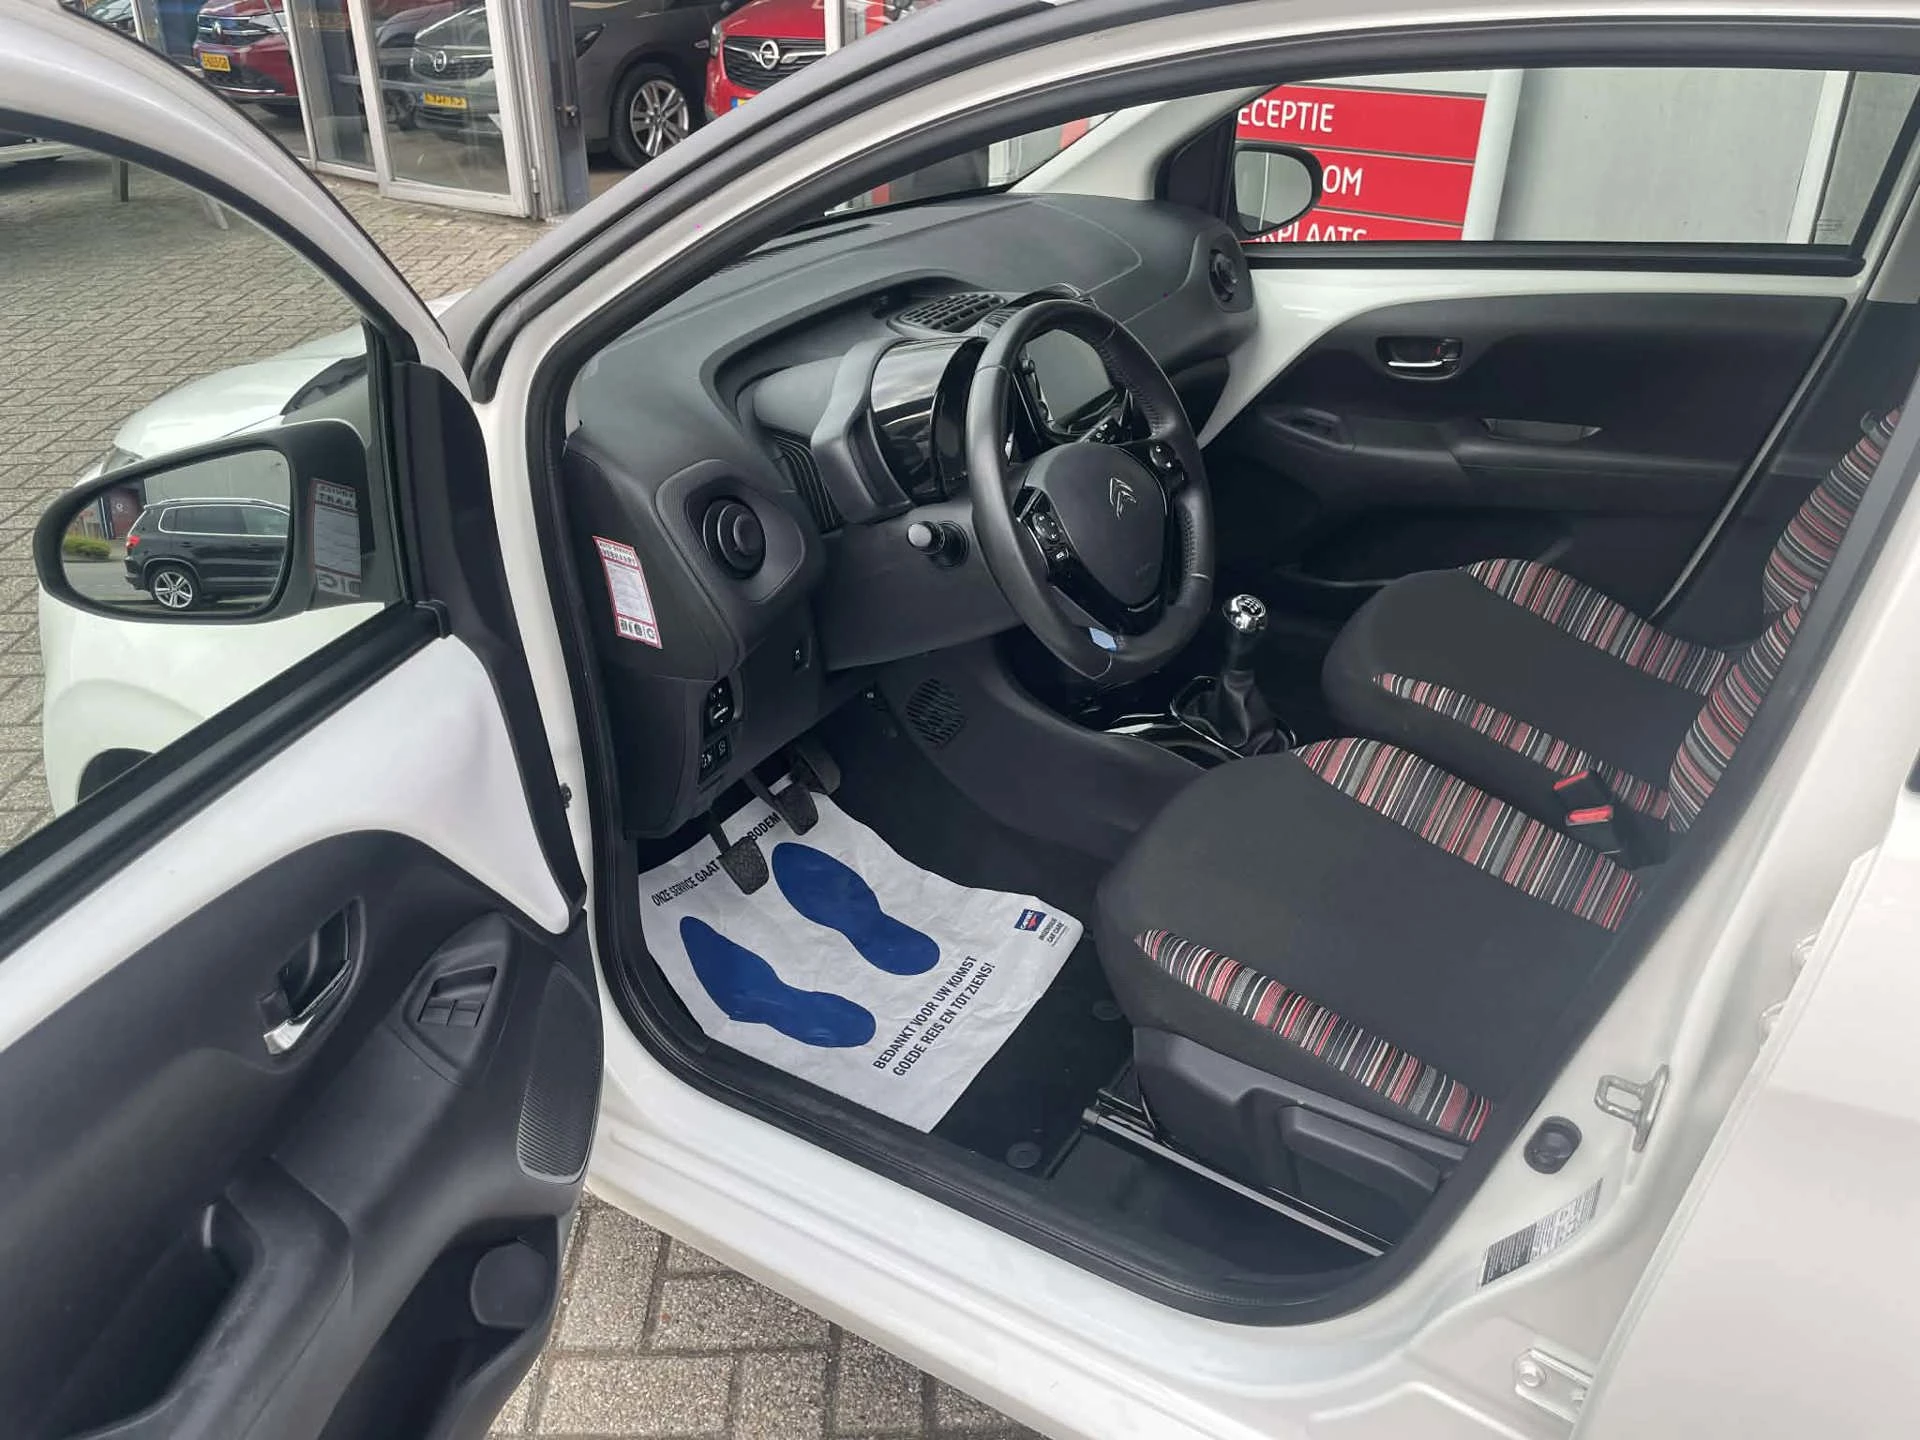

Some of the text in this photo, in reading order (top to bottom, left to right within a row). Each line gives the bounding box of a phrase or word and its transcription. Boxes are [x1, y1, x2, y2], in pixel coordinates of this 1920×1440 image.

[651, 812, 781, 906] ONZE SERVICE GAAT BODEM
[872, 955, 977, 1069] BEDANKT VOOR UW KOMST
[892, 962, 996, 1076] GOEDE REIS EN TOT ZIENS!
